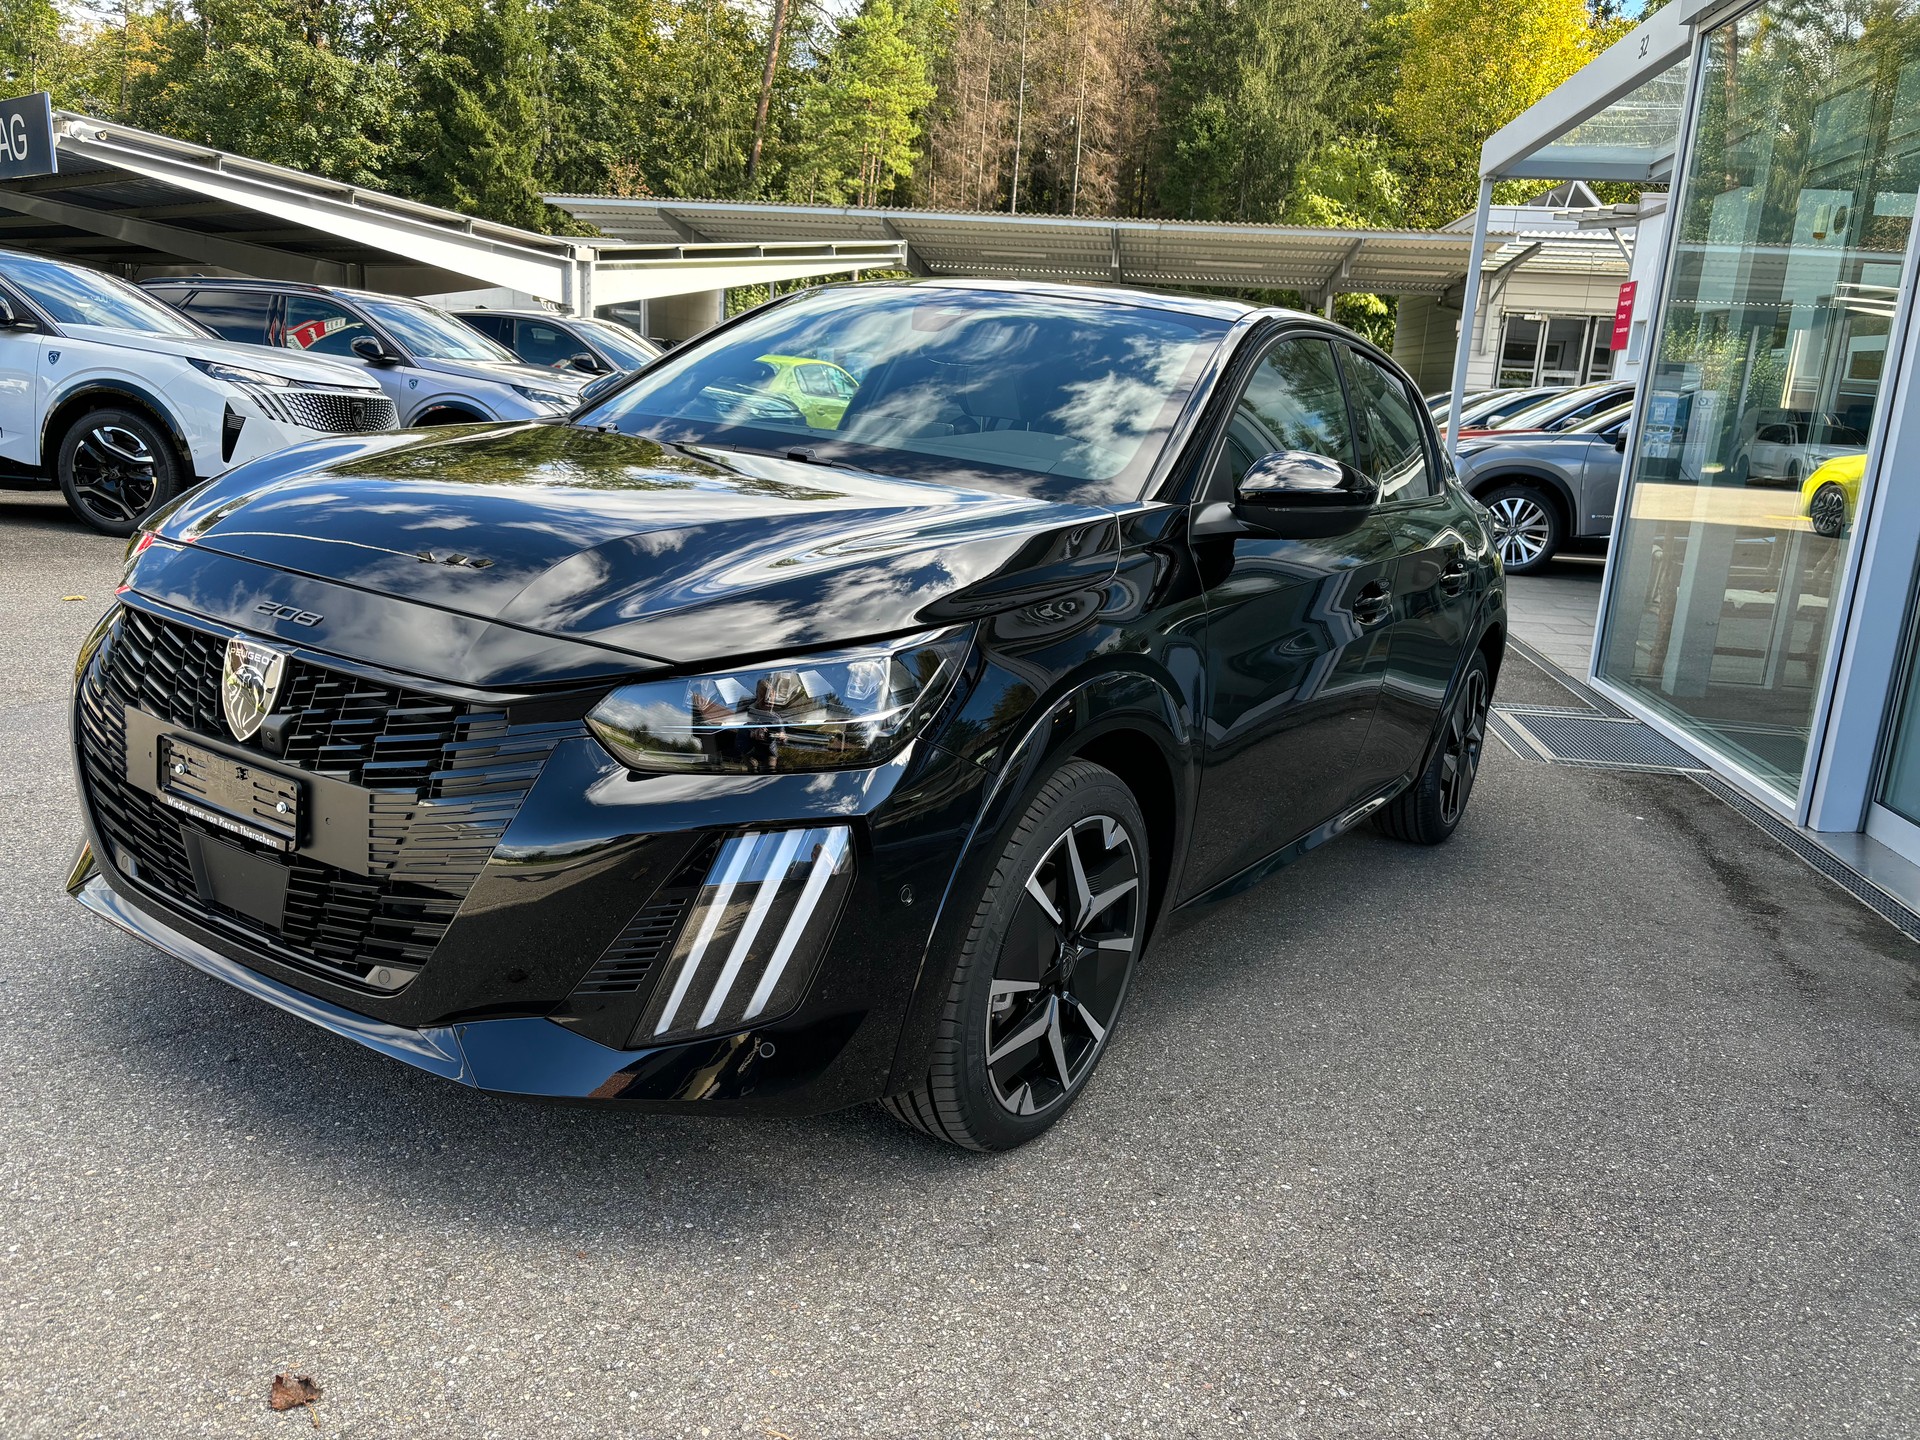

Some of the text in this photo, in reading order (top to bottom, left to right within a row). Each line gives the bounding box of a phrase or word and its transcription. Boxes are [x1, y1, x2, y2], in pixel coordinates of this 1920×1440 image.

[1638, 33, 1650, 60] 32
[0, 113, 28, 163] AG
[253, 600, 324, 627] 208
[229, 647, 278, 668] PEUGEOT
[166, 795, 277, 848] Wieder einer von Pieren Thierachern
